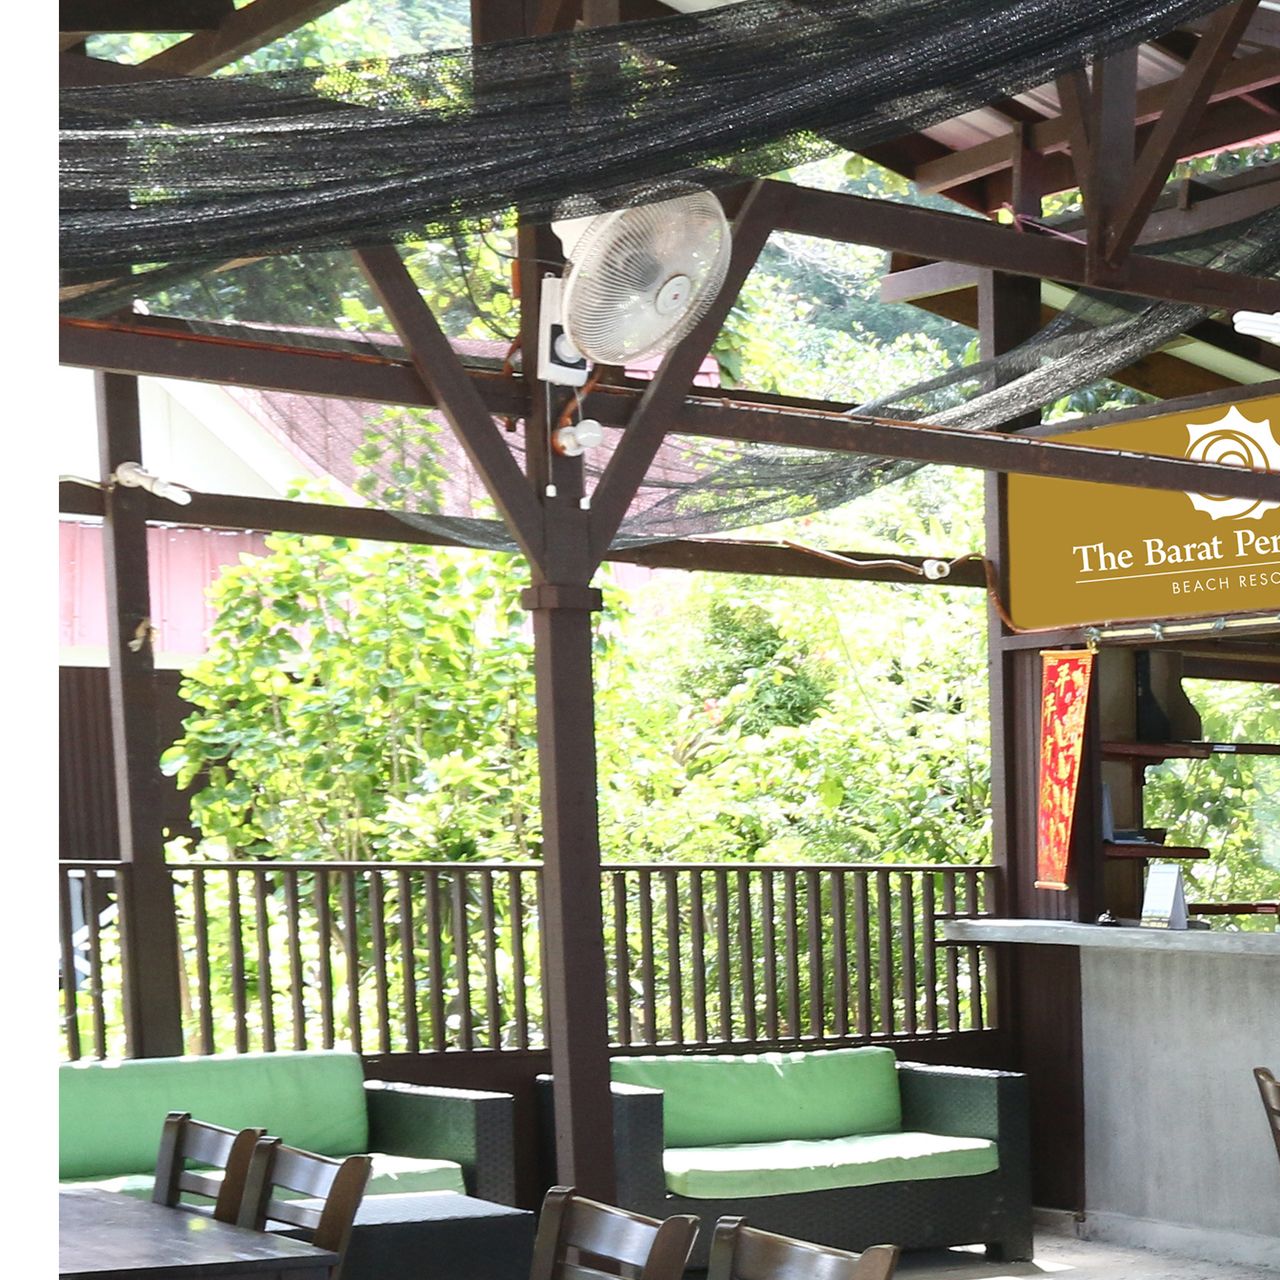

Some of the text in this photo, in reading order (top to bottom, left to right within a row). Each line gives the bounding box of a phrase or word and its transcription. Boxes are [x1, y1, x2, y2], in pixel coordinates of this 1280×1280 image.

[1072, 542, 1134, 574] The
[1143, 535, 1224, 567] Barat
[1172, 576, 1230, 595] BEACH
